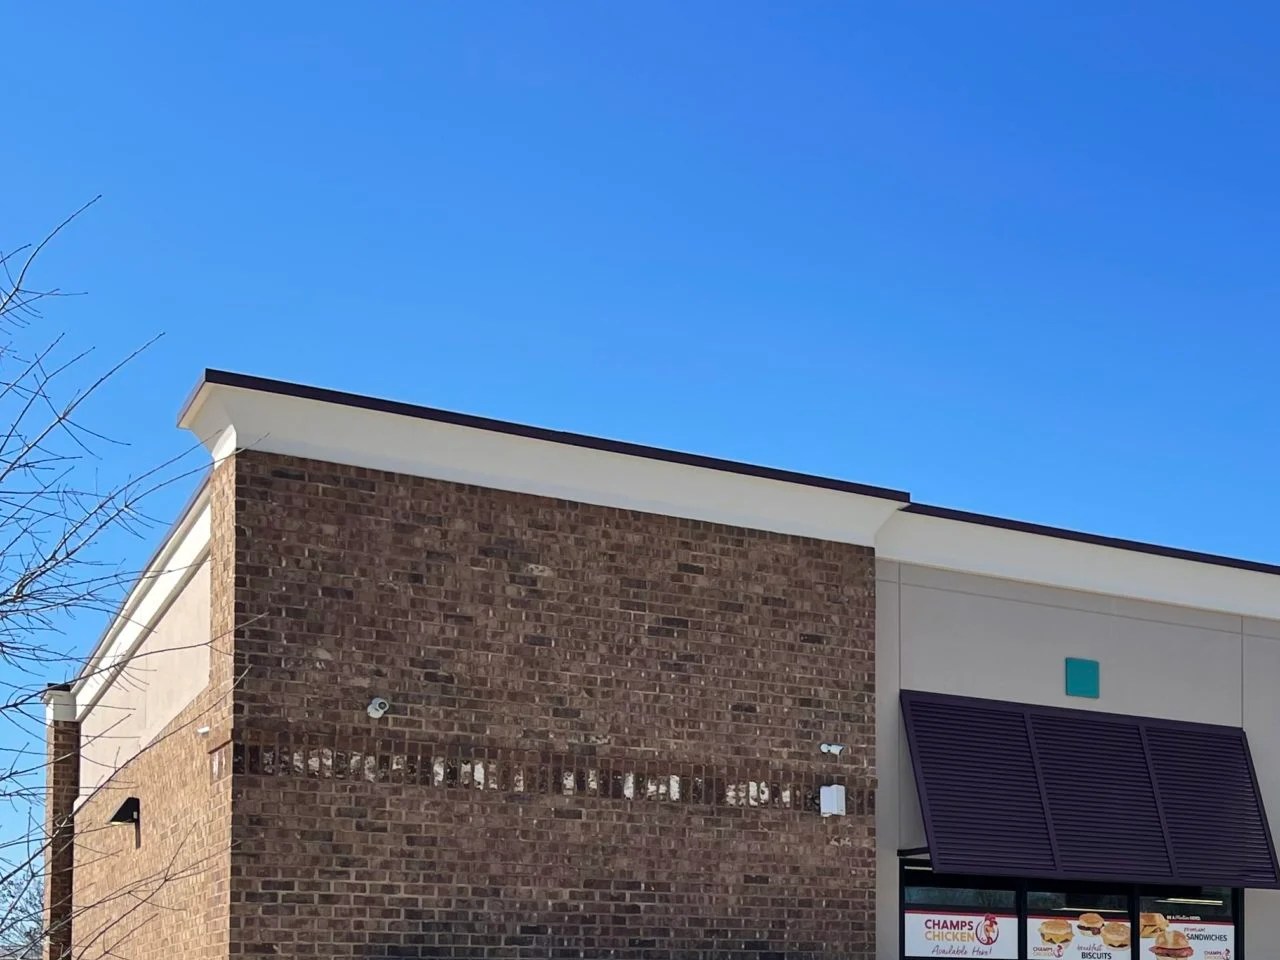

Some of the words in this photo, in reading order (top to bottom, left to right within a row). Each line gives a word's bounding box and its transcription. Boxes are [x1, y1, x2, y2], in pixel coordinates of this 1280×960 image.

[924, 919, 974, 931] CHAMPS
[924, 930, 976, 942] CHICKEN
[1186, 933, 1228, 942] SANDWICHES
[931, 945, 968, 956] Available
[971, 946, 992, 956] Here!
[1081, 952, 1112, 960] BISCUITS
